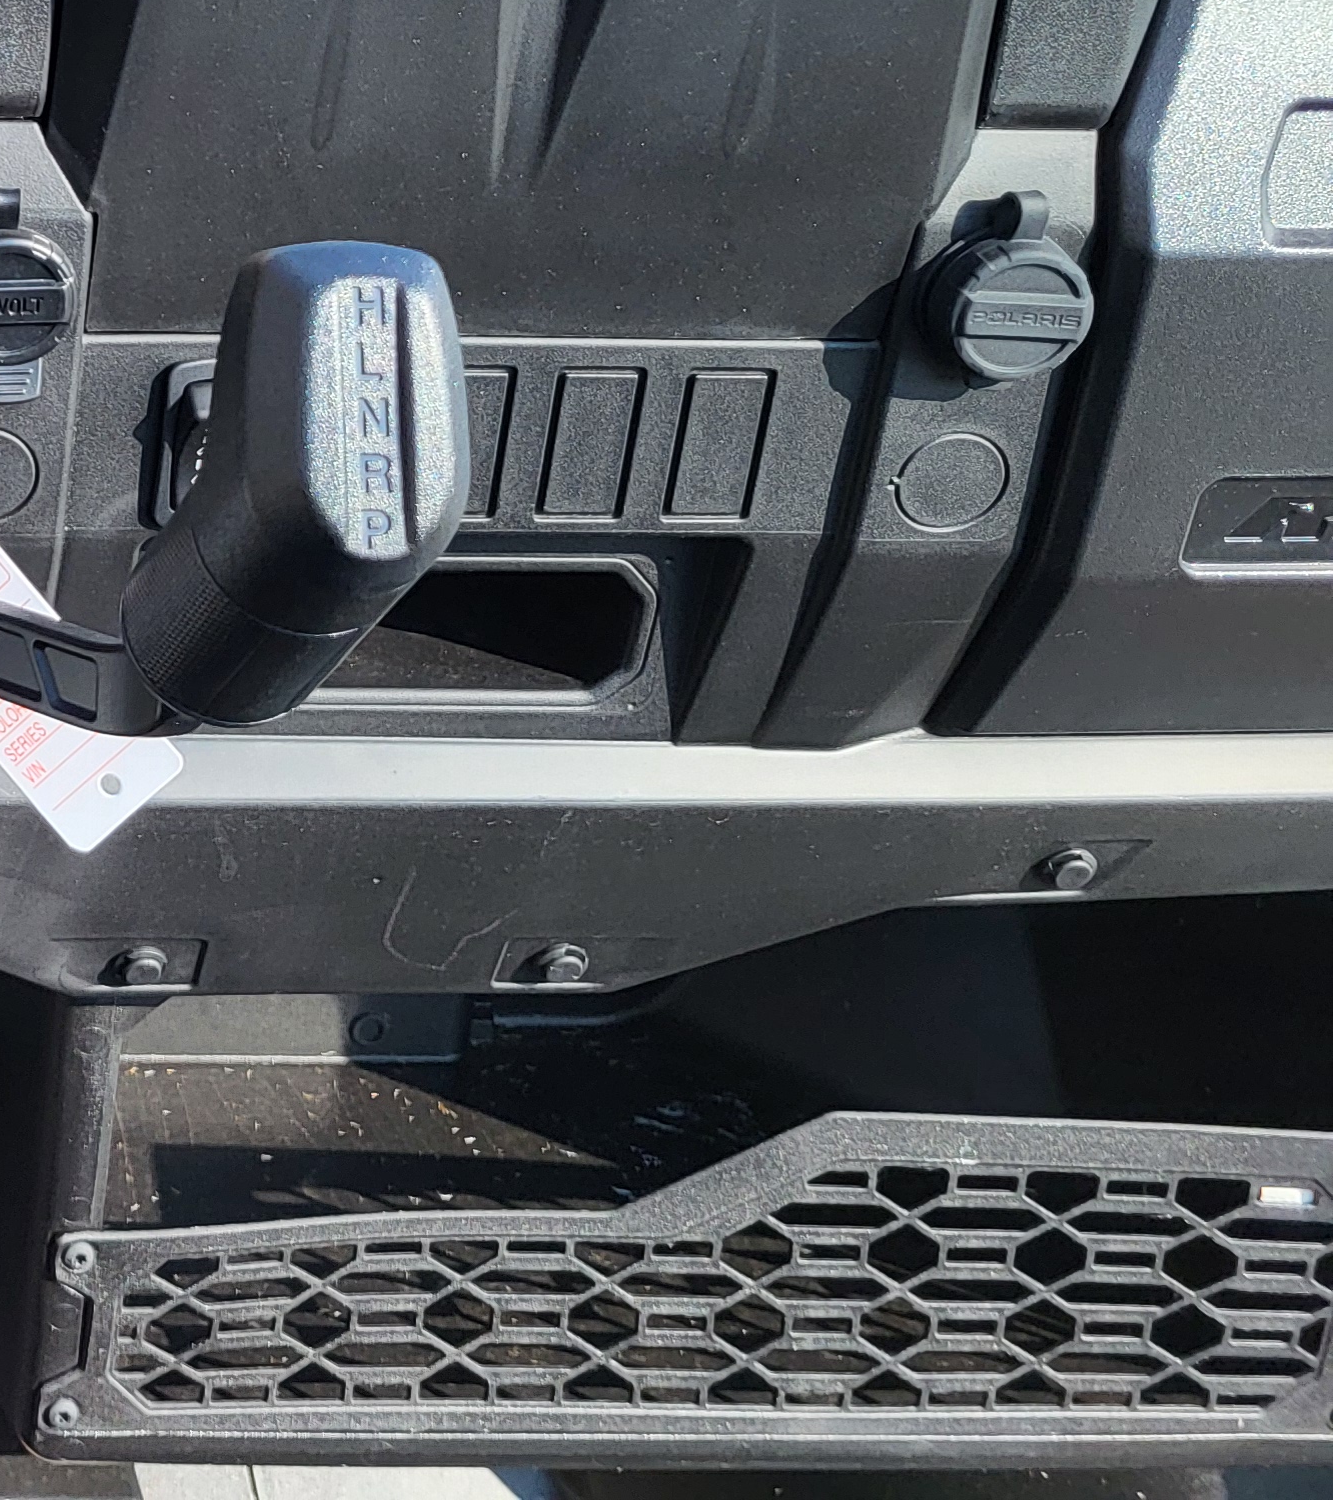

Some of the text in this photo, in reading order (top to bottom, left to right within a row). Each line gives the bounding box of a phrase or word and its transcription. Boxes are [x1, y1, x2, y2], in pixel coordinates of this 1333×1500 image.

[353, 285, 384, 326] H
[968, 310, 1082, 330] POLARIS
[356, 340, 383, 382] L
[359, 397, 391, 438] N
[360, 453, 393, 493] R
[361, 509, 392, 550] P
[4, 721, 47, 762] SERIES
[21, 760, 48, 784] VIN
